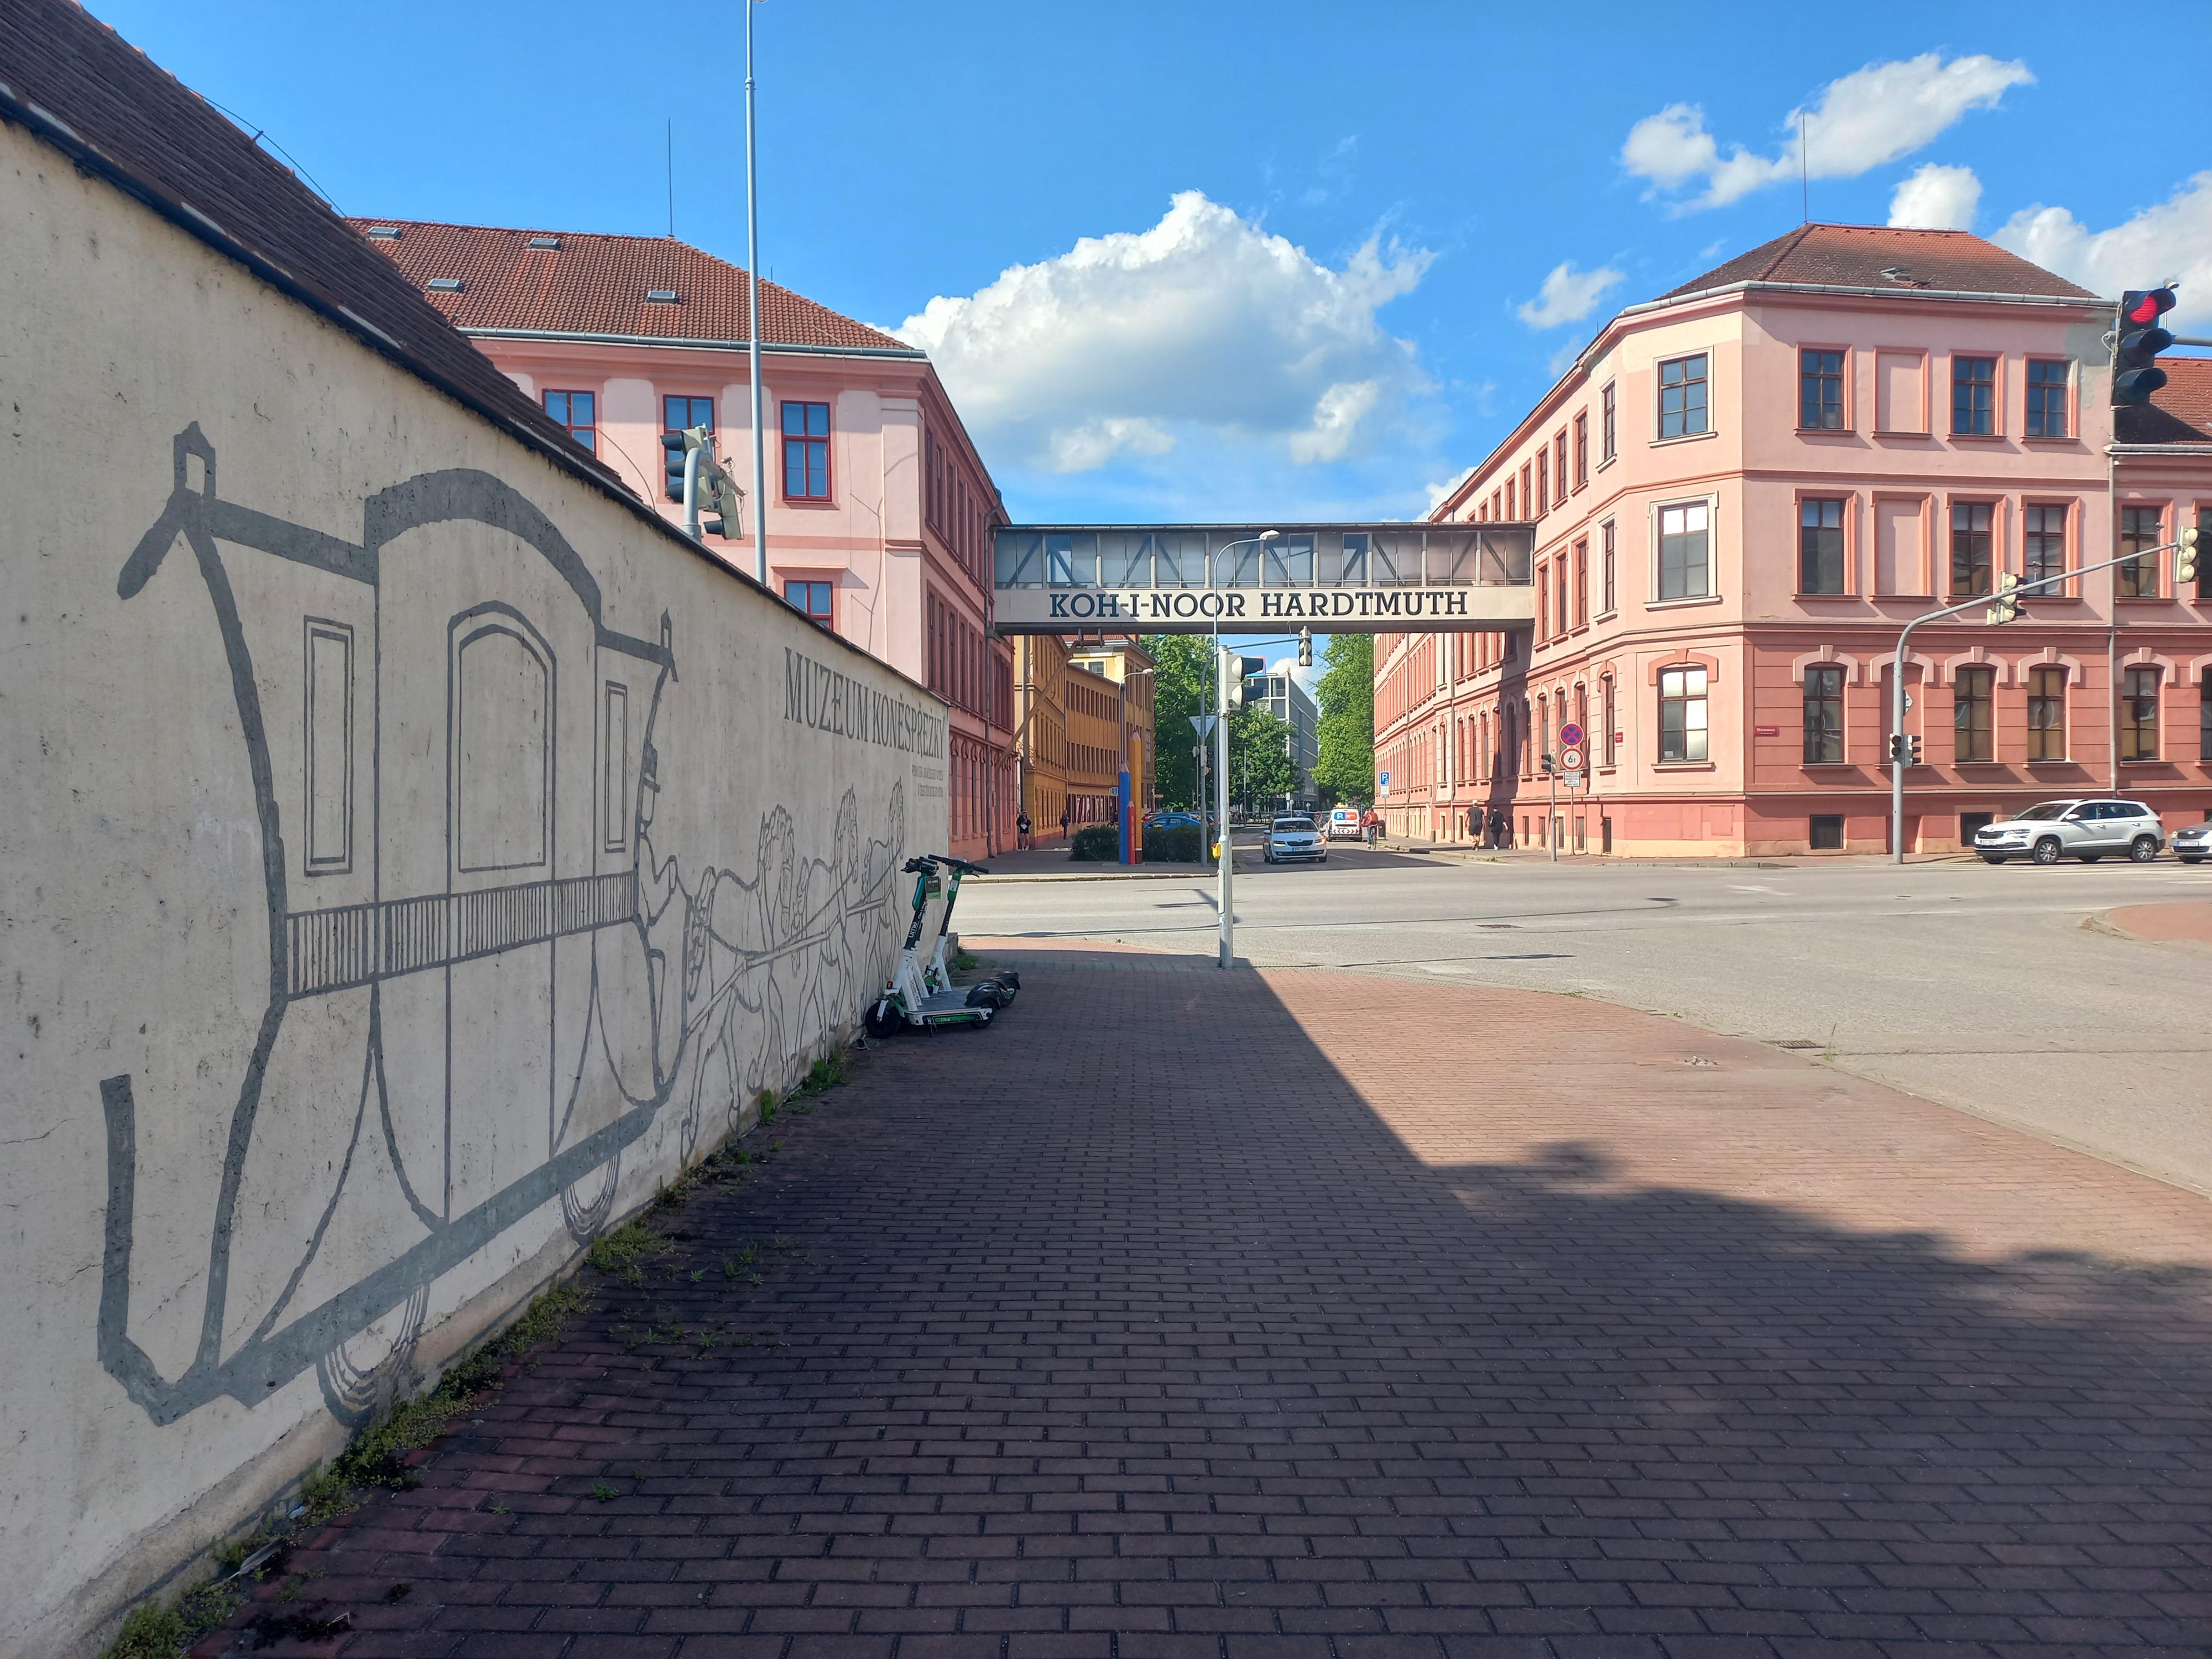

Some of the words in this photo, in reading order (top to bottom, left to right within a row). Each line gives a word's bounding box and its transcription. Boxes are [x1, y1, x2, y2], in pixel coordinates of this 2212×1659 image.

[1050, 593, 1245, 618] KOH-I-NOOR
[1260, 592, 1468, 617] HARDTMUTH
[784, 646, 869, 743] MUZEUM
[1381, 773, 1387, 781] P
